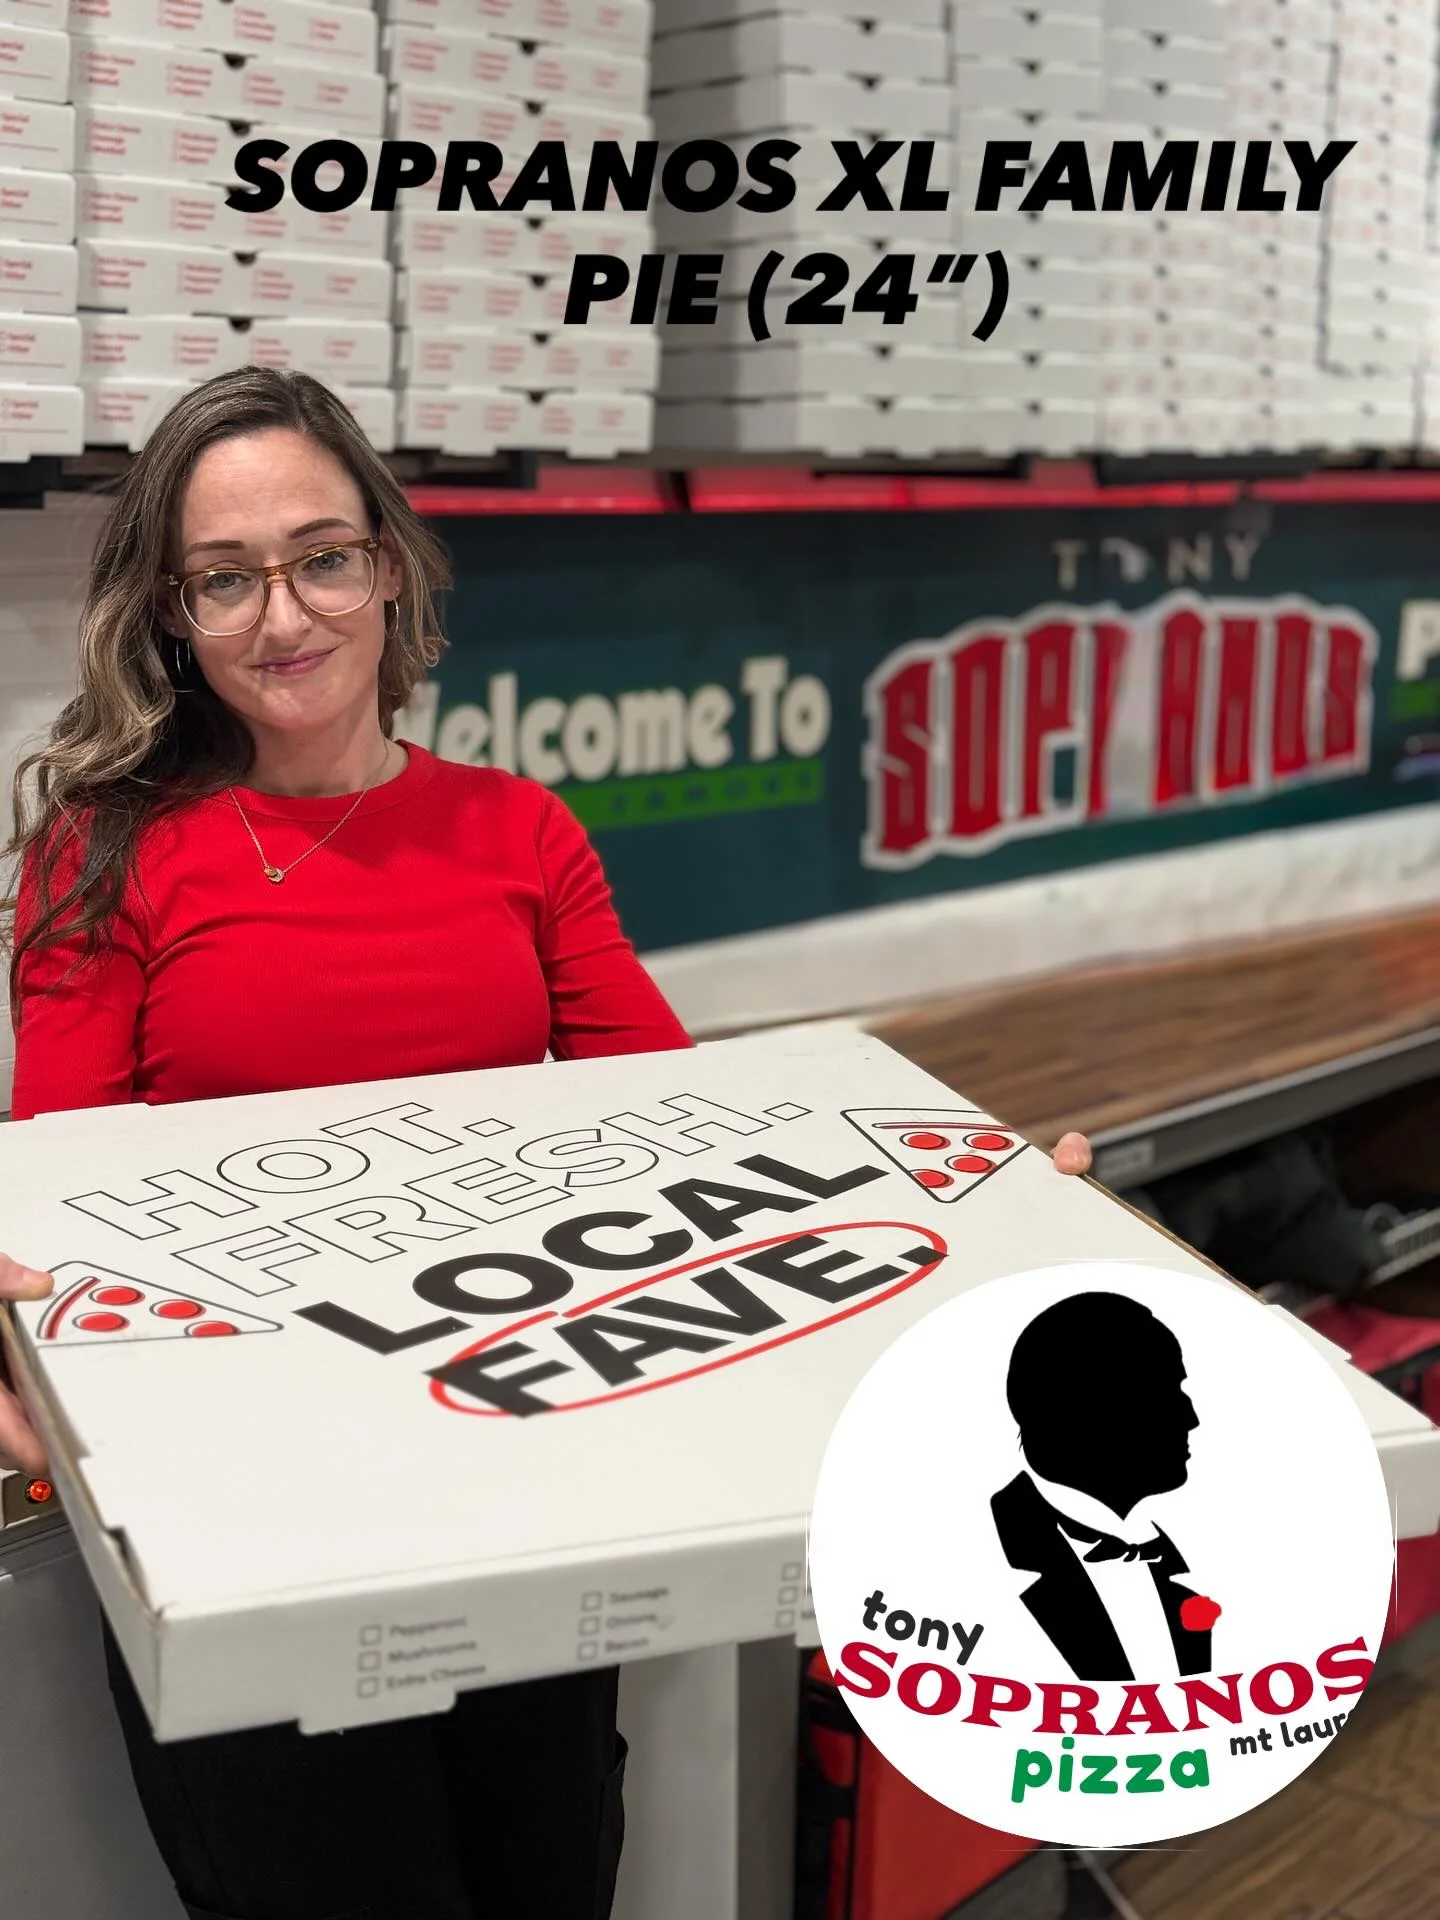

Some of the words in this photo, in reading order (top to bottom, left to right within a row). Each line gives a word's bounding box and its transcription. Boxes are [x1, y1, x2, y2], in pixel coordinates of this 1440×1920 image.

[1051, 533, 1262, 591] TNY
[741, 655, 831, 762] To
[63, 1103, 515, 1240] HOT.
[171, 1093, 813, 1297] FRESH.
[292, 1154, 890, 1355] LOCAL
[423, 1233, 949, 1418] FAVE.
